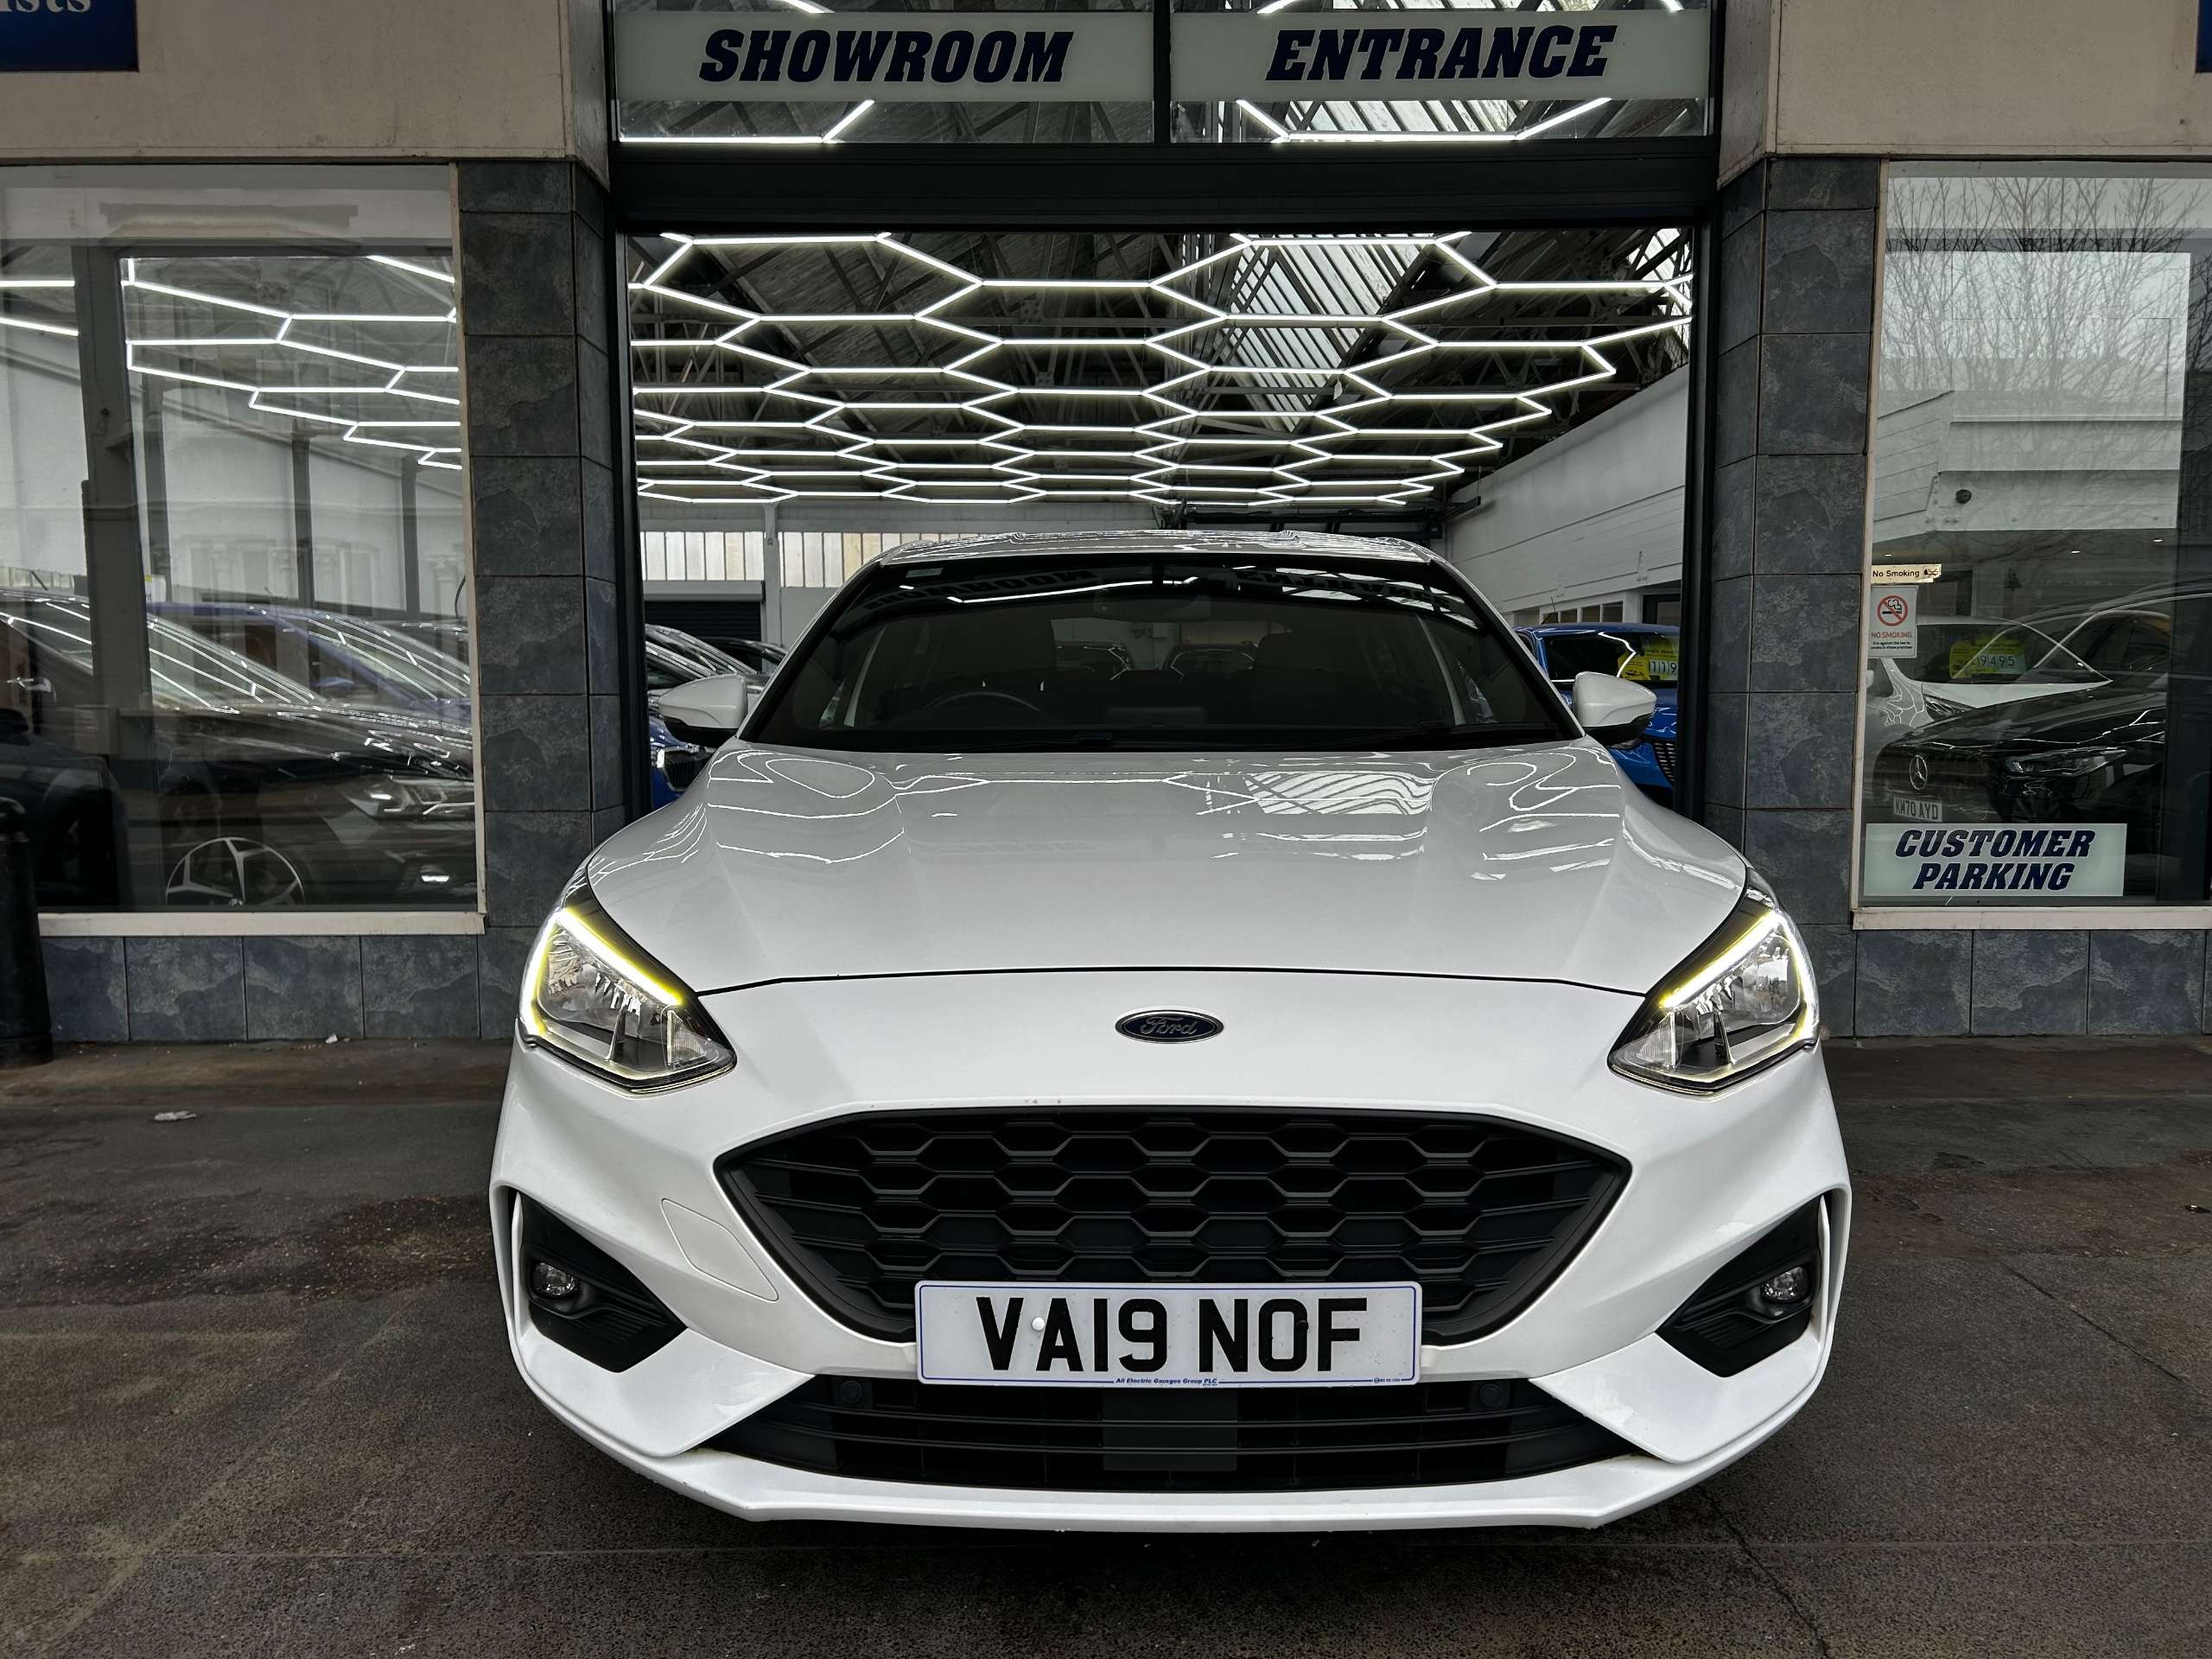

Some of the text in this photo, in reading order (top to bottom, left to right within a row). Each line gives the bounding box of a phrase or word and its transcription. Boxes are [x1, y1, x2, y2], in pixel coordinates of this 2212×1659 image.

[698, 24, 1617, 86] SHOWROOM ENTRANCE
[1919, 803, 1938, 820] AYD
[1896, 830, 2095, 858] CUSTOMER
[1912, 862, 2075, 891] PARKING
[1140, 1016, 1198, 1035] Ford
[976, 1297, 1368, 1373] VA19 NOF
